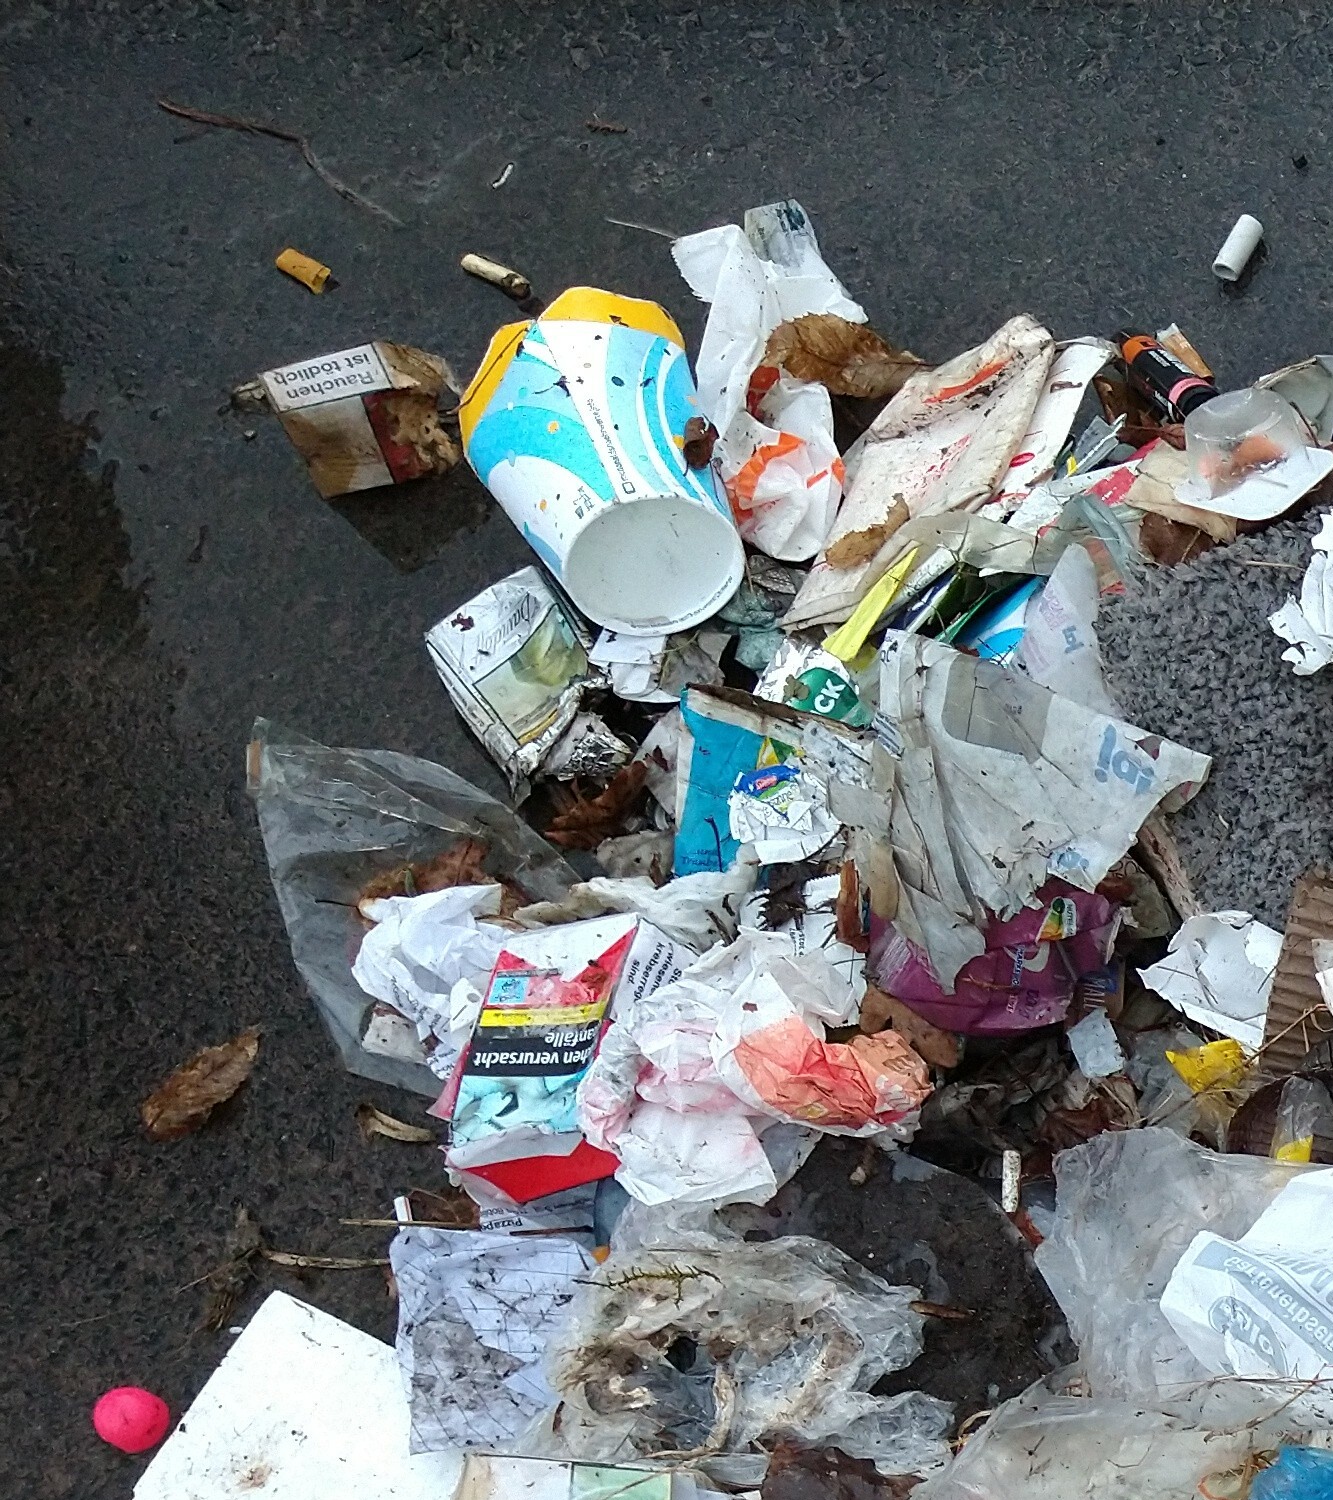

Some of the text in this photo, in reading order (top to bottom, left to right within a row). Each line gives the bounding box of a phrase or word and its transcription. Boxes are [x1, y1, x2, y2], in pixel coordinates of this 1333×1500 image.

[274, 353, 372, 386] ist tödlich
[286, 371, 376, 399] Rauchen
[474, 1051, 559, 1068] verursacht
